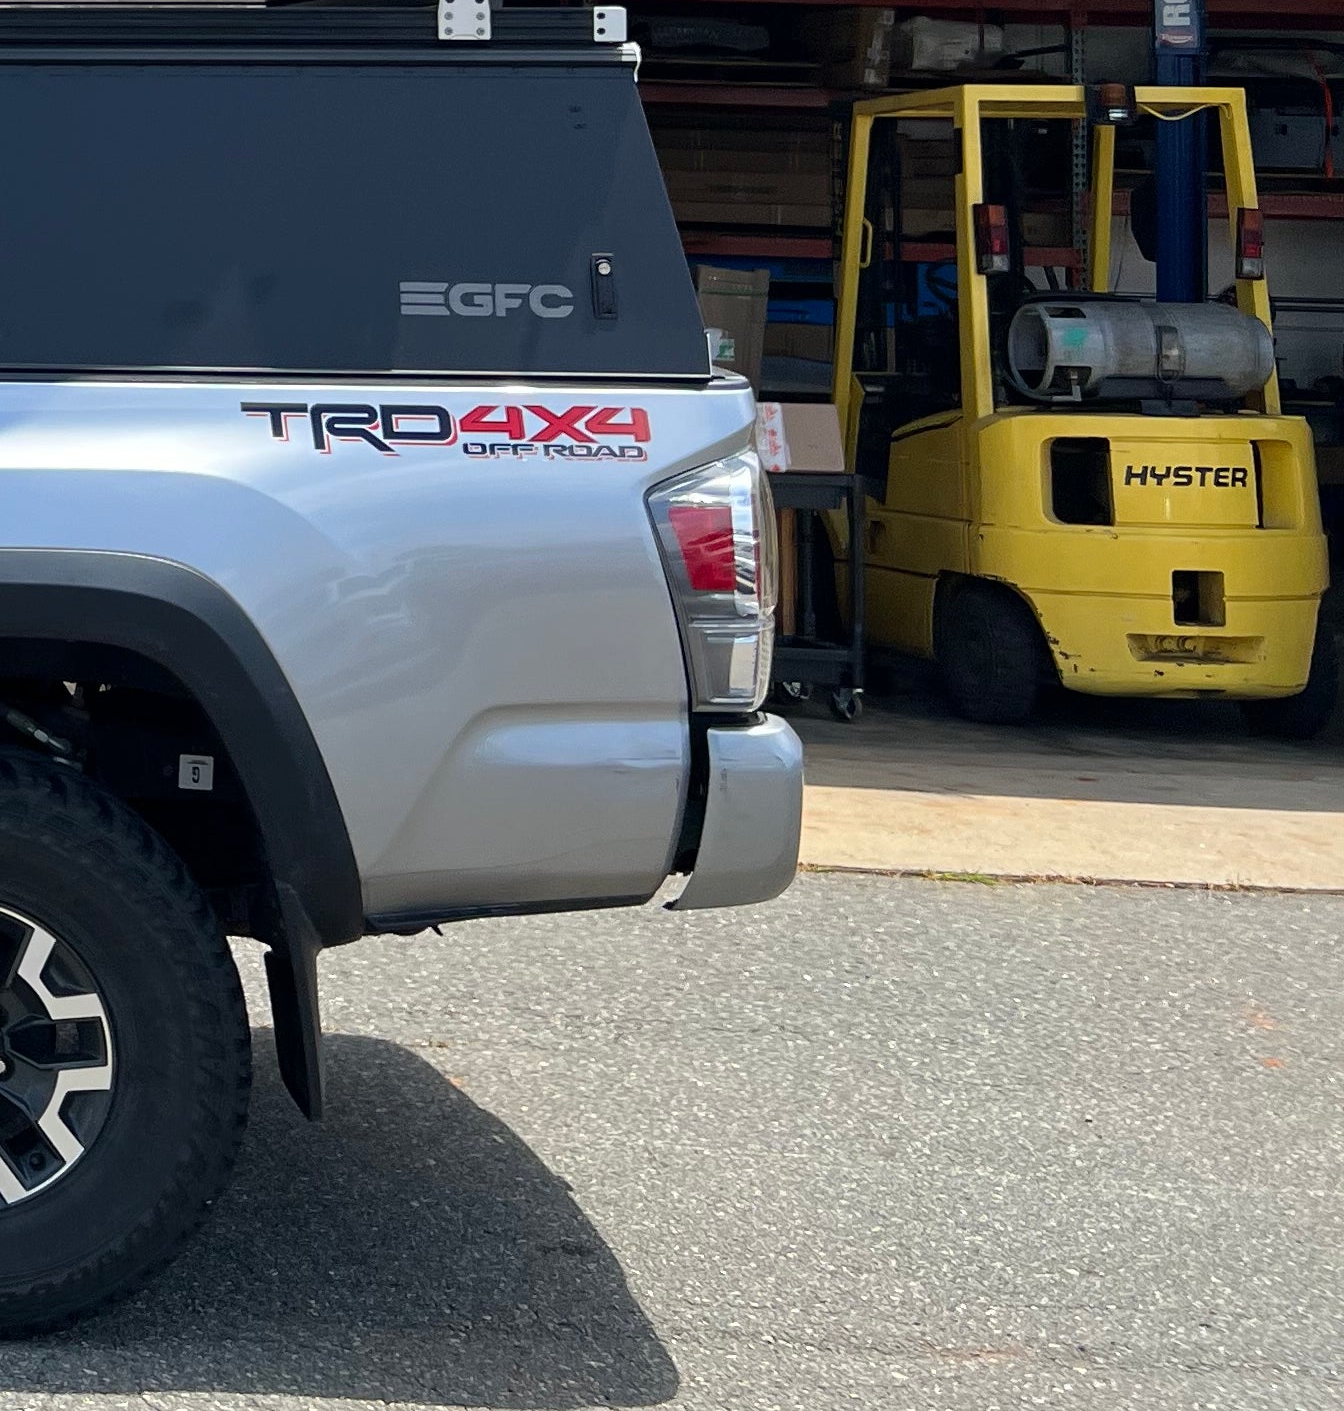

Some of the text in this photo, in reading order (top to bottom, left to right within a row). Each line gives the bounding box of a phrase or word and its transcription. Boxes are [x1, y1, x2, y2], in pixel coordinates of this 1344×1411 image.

[240, 402, 459, 456] TRD
[461, 442, 649, 461] OFF ROAD
[1124, 465, 1248, 487] HYSTER
